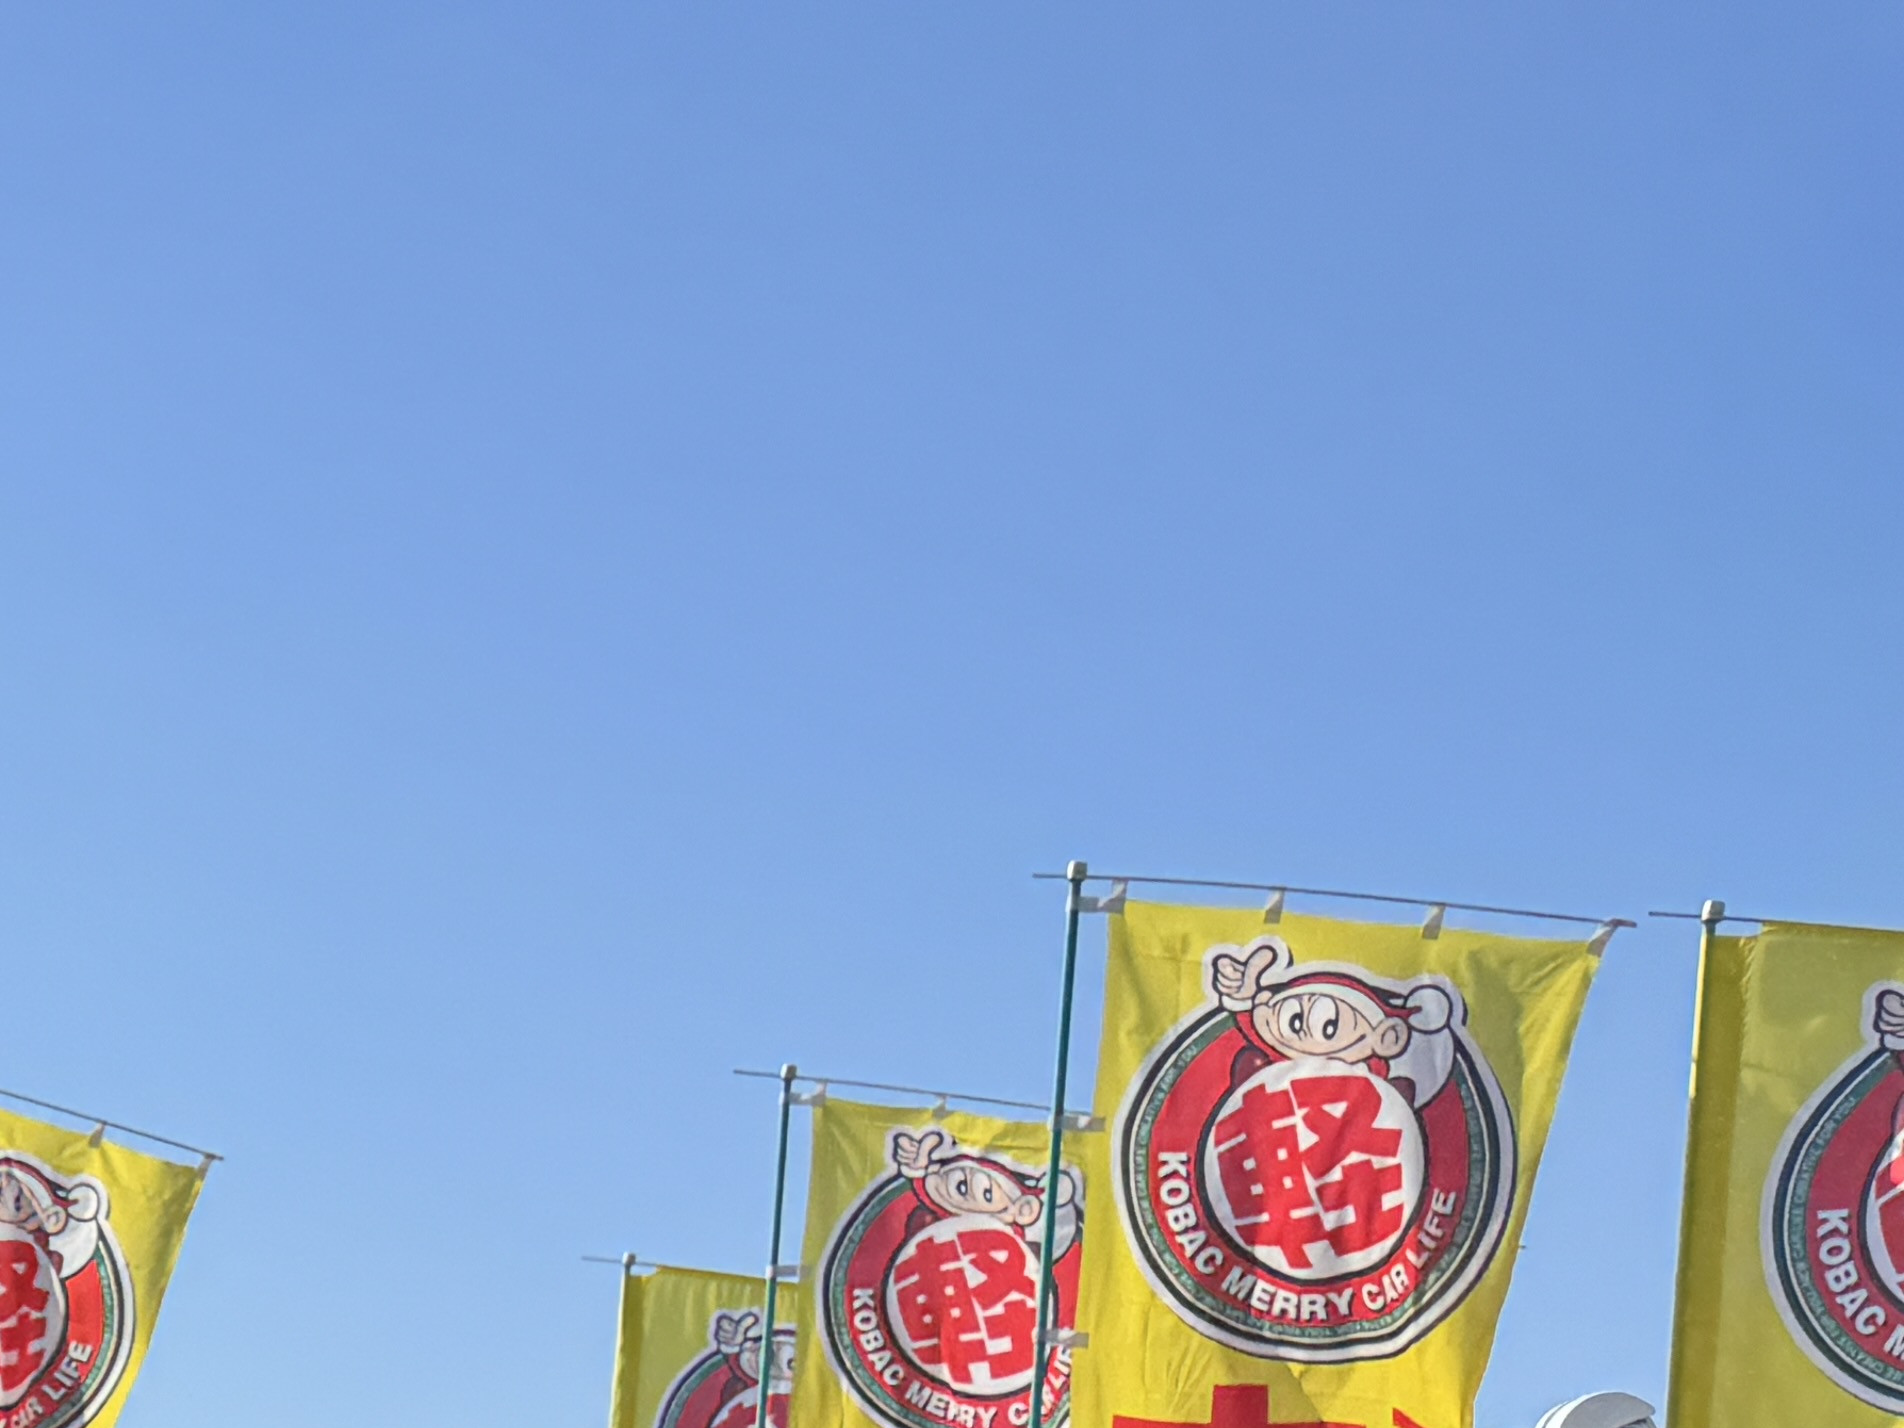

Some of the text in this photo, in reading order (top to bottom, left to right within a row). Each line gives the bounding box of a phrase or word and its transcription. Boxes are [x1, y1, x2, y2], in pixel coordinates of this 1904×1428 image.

[1157, 1151, 1224, 1275] KOBAC
[1221, 1264, 1355, 1321] MERRY
[1360, 1263, 1410, 1311] CAR
[1405, 1190, 1456, 1269] LIFE
[1215, 1075, 1405, 1267] 軽
[851, 1288, 904, 1386] KOBAC
[892, 1229, 1043, 1386] 軽
[1817, 1208, 1886, 1335] KOBAC
[42, 1341, 92, 1400] LIFE
